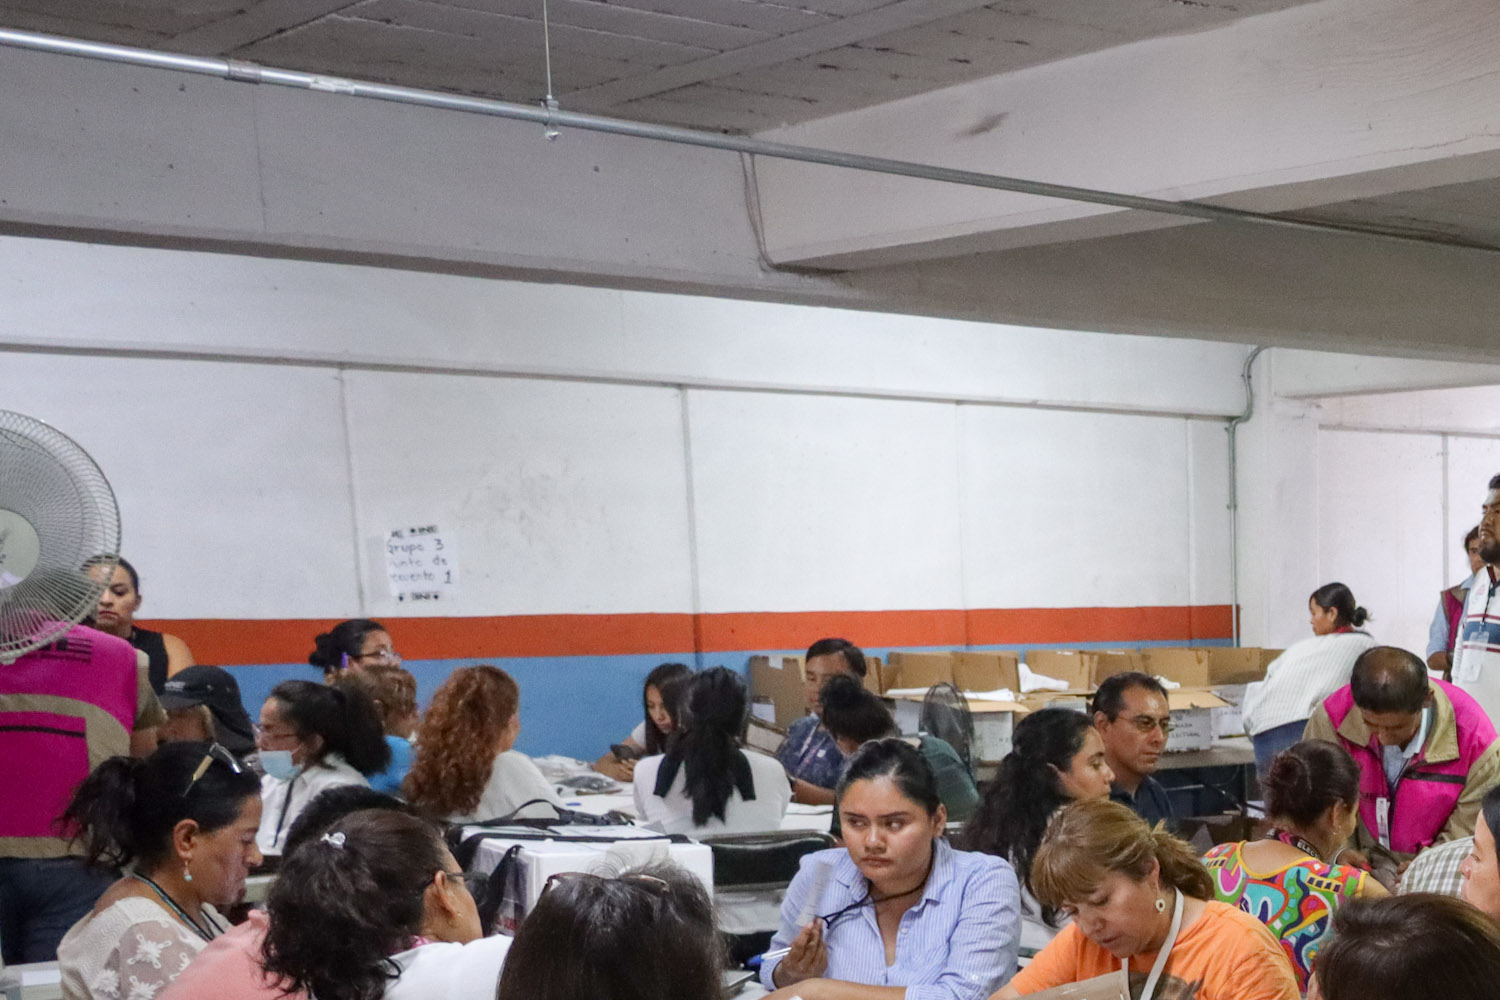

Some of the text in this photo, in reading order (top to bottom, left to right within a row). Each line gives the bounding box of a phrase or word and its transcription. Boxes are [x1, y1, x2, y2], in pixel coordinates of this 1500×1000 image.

[434, 538, 444, 551] 3
[444, 570, 452, 584] 1
[1297, 839, 1319, 859] ELEC
